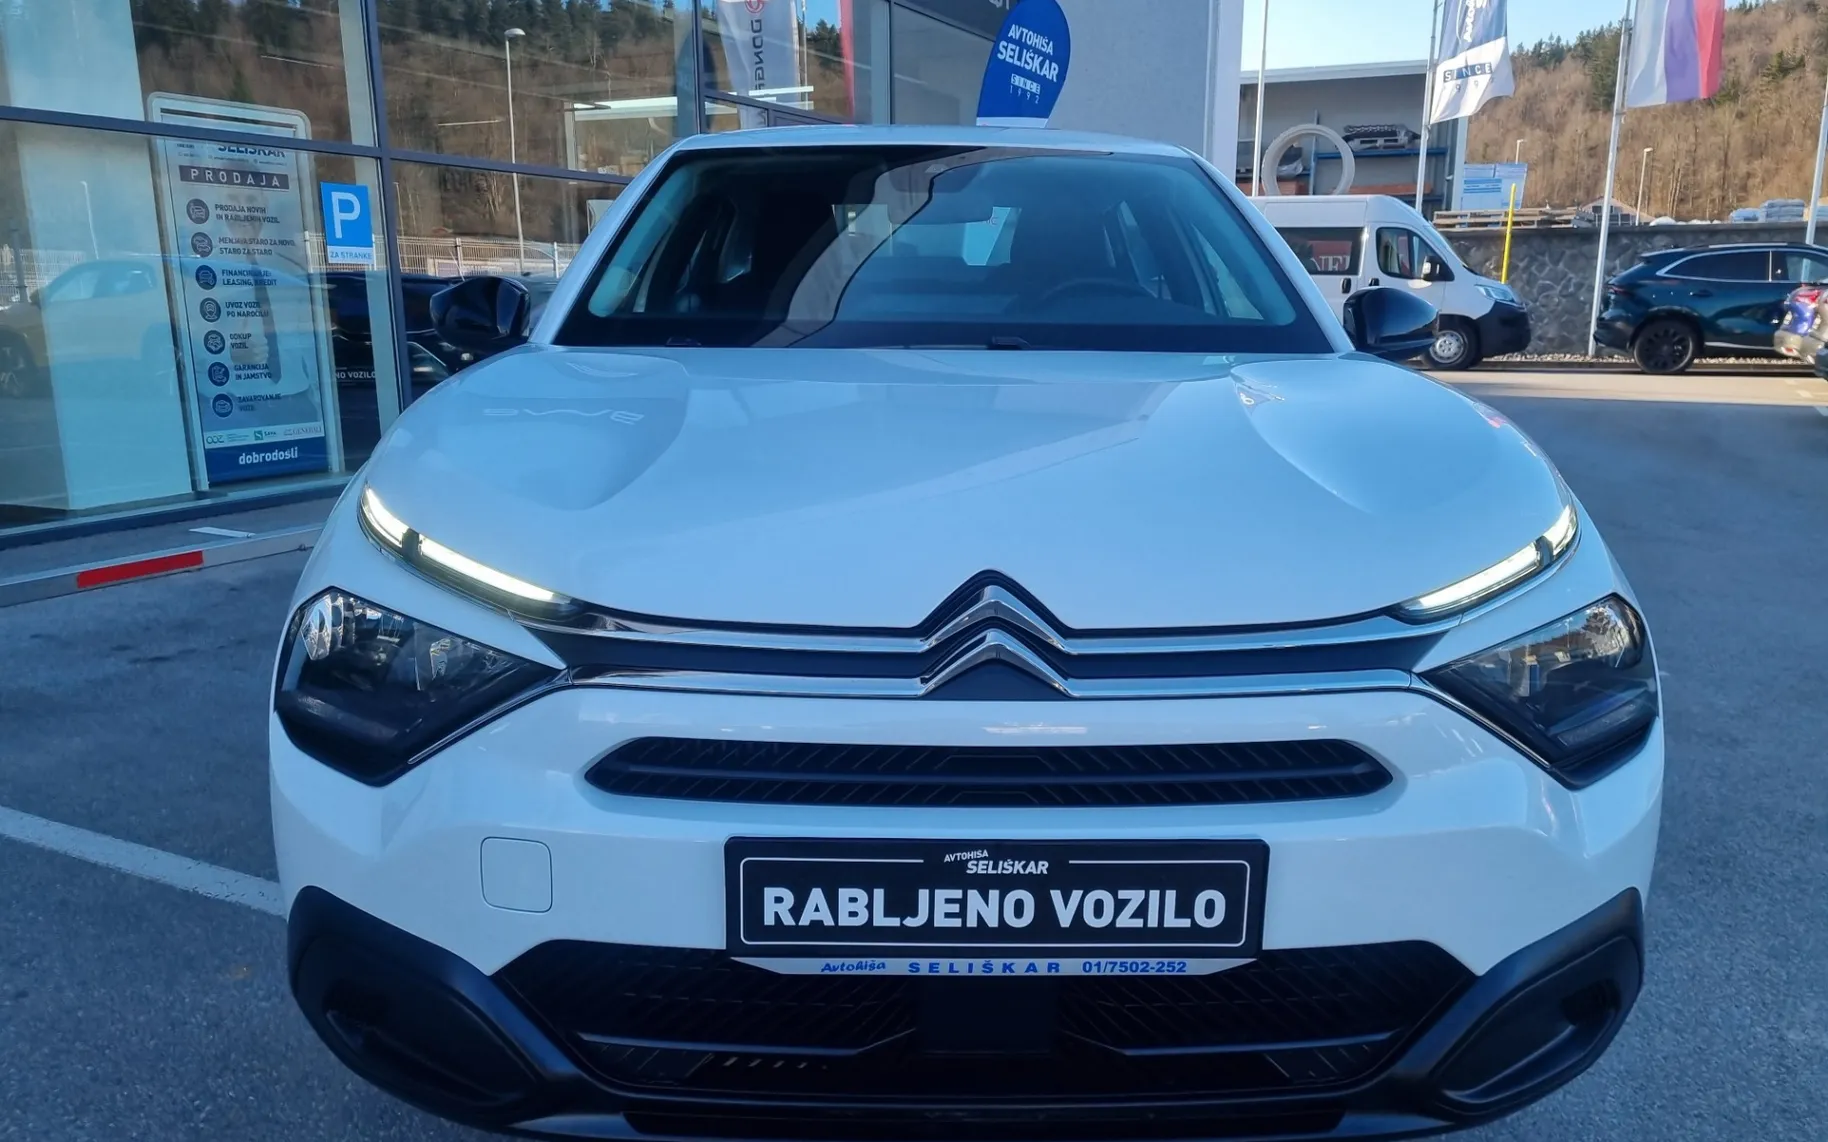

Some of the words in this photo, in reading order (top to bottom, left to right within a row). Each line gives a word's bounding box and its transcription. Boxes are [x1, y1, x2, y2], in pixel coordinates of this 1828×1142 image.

[1008, 24, 1053, 55] AVTOHIŠA
[997, 40, 1059, 82] SELIŠKAR
[1444, 63, 1492, 82] SINCE
[1011, 74, 1040, 94] SINCE
[1010, 85, 1040, 104] 1992
[190, 168, 281, 187] PRODAJA
[215, 204, 246, 213] PRODAJA
[247, 206, 266, 214] NOVIH
[331, 191, 361, 239] P
[248, 238, 269, 246] STARO
[269, 238, 278, 246] ZA
[219, 247, 242, 255] STARO
[252, 248, 273, 256] STARO
[329, 251, 340, 259] ZA
[341, 251, 372, 260] STRANKE
[222, 278, 254, 287] LEASING,
[225, 301, 243, 309] UVOZ
[227, 310, 236, 318] PO
[235, 373, 242, 381] IN
[243, 372, 272, 380] JAMSTVO
[238, 446, 299, 465] dobrodošli
[966, 859, 1049, 875] SELIŠKAR
[763, 886, 1035, 928] RABLJENO
[1050, 889, 1227, 928] VOZILO
[820, 960, 887, 973] Avtohiša
[907, 959, 1061, 974] SELIŠKAR
[1081, 960, 1187, 974] 01/7502-252
